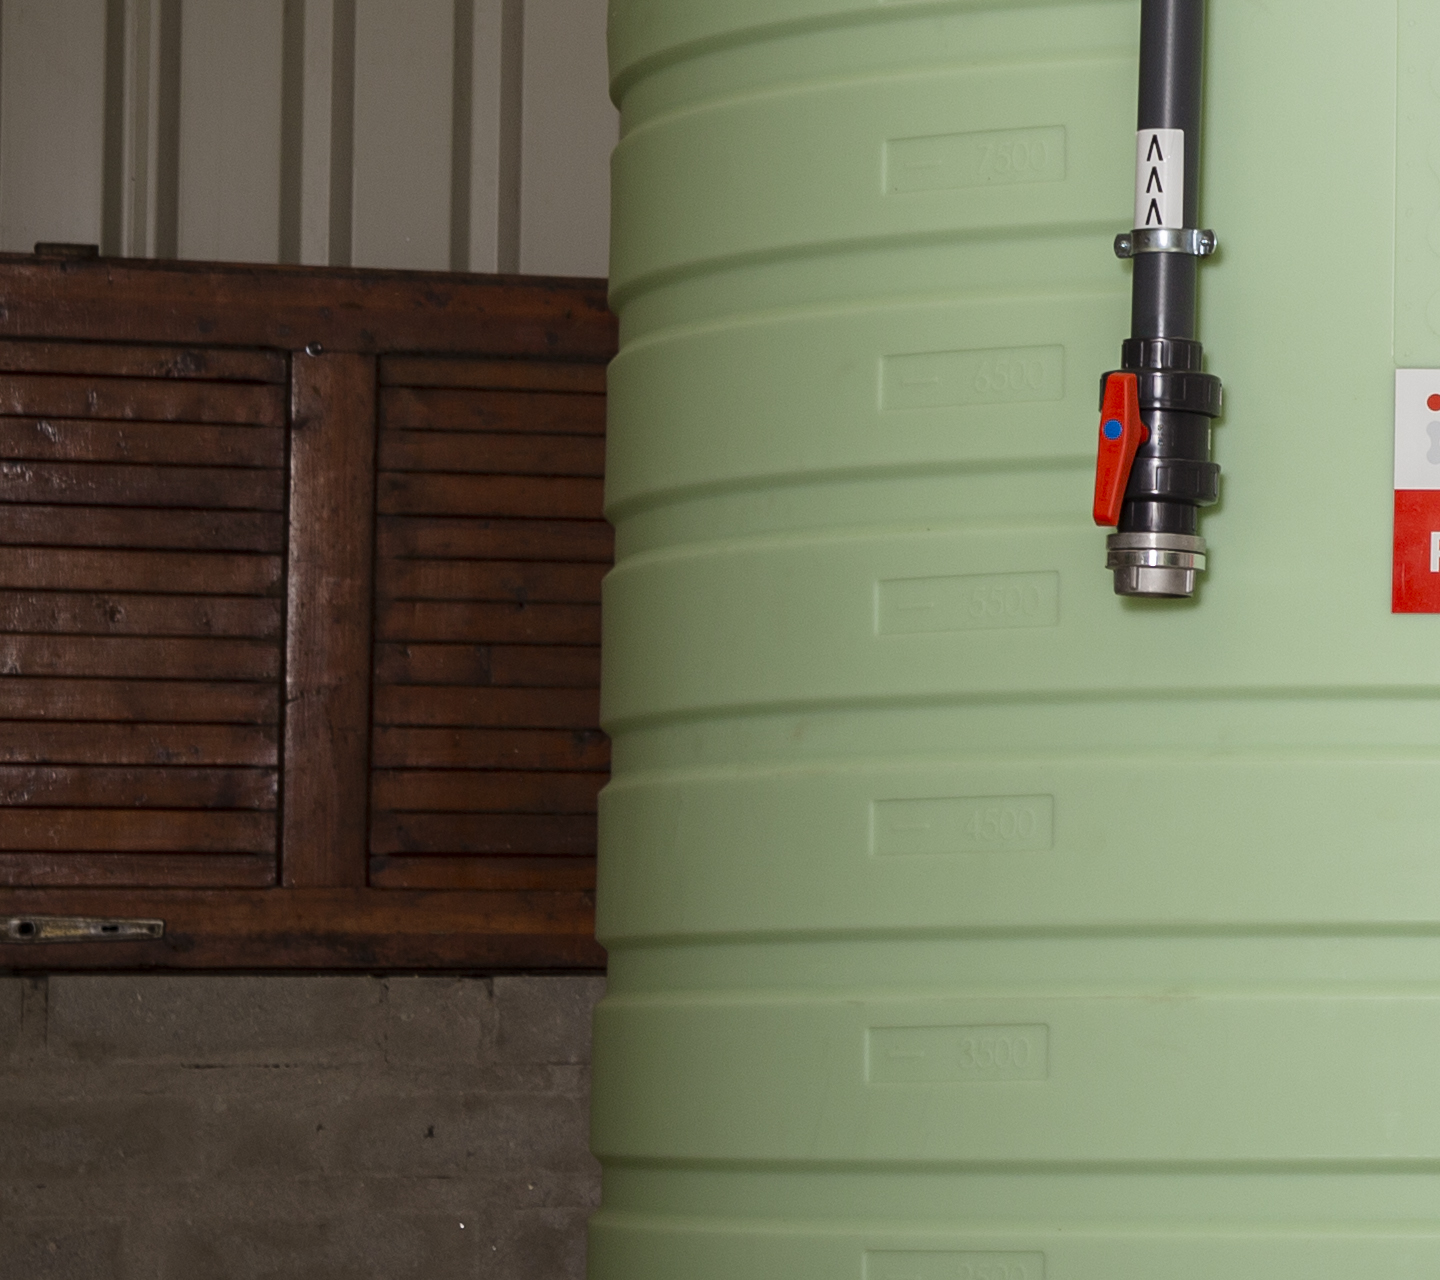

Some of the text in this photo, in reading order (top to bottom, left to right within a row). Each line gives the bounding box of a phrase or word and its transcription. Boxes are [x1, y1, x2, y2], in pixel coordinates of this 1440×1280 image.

[976, 139, 1050, 175] 7500
[973, 358, 1046, 394] 6500
[968, 584, 1040, 619] 5500
[965, 807, 1037, 841] 4500
[958, 1036, 1033, 1070] 3500
